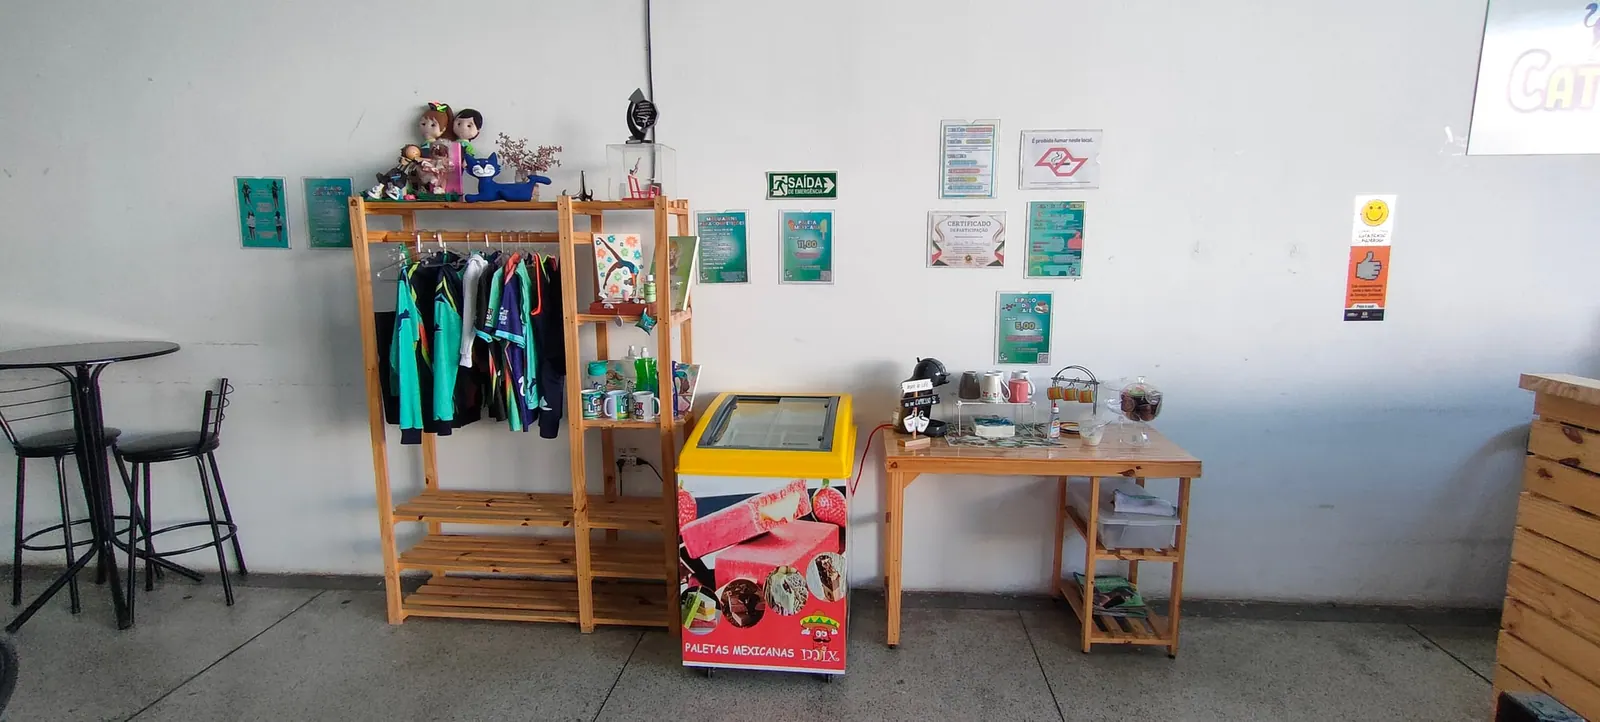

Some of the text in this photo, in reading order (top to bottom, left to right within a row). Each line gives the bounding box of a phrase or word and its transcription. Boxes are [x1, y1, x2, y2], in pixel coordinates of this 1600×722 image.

[788, 174, 823, 188] SAÍDA
[1015, 322, 1035, 331] 5,00
[685, 643, 795, 658] PALETAS MEXICANAS
